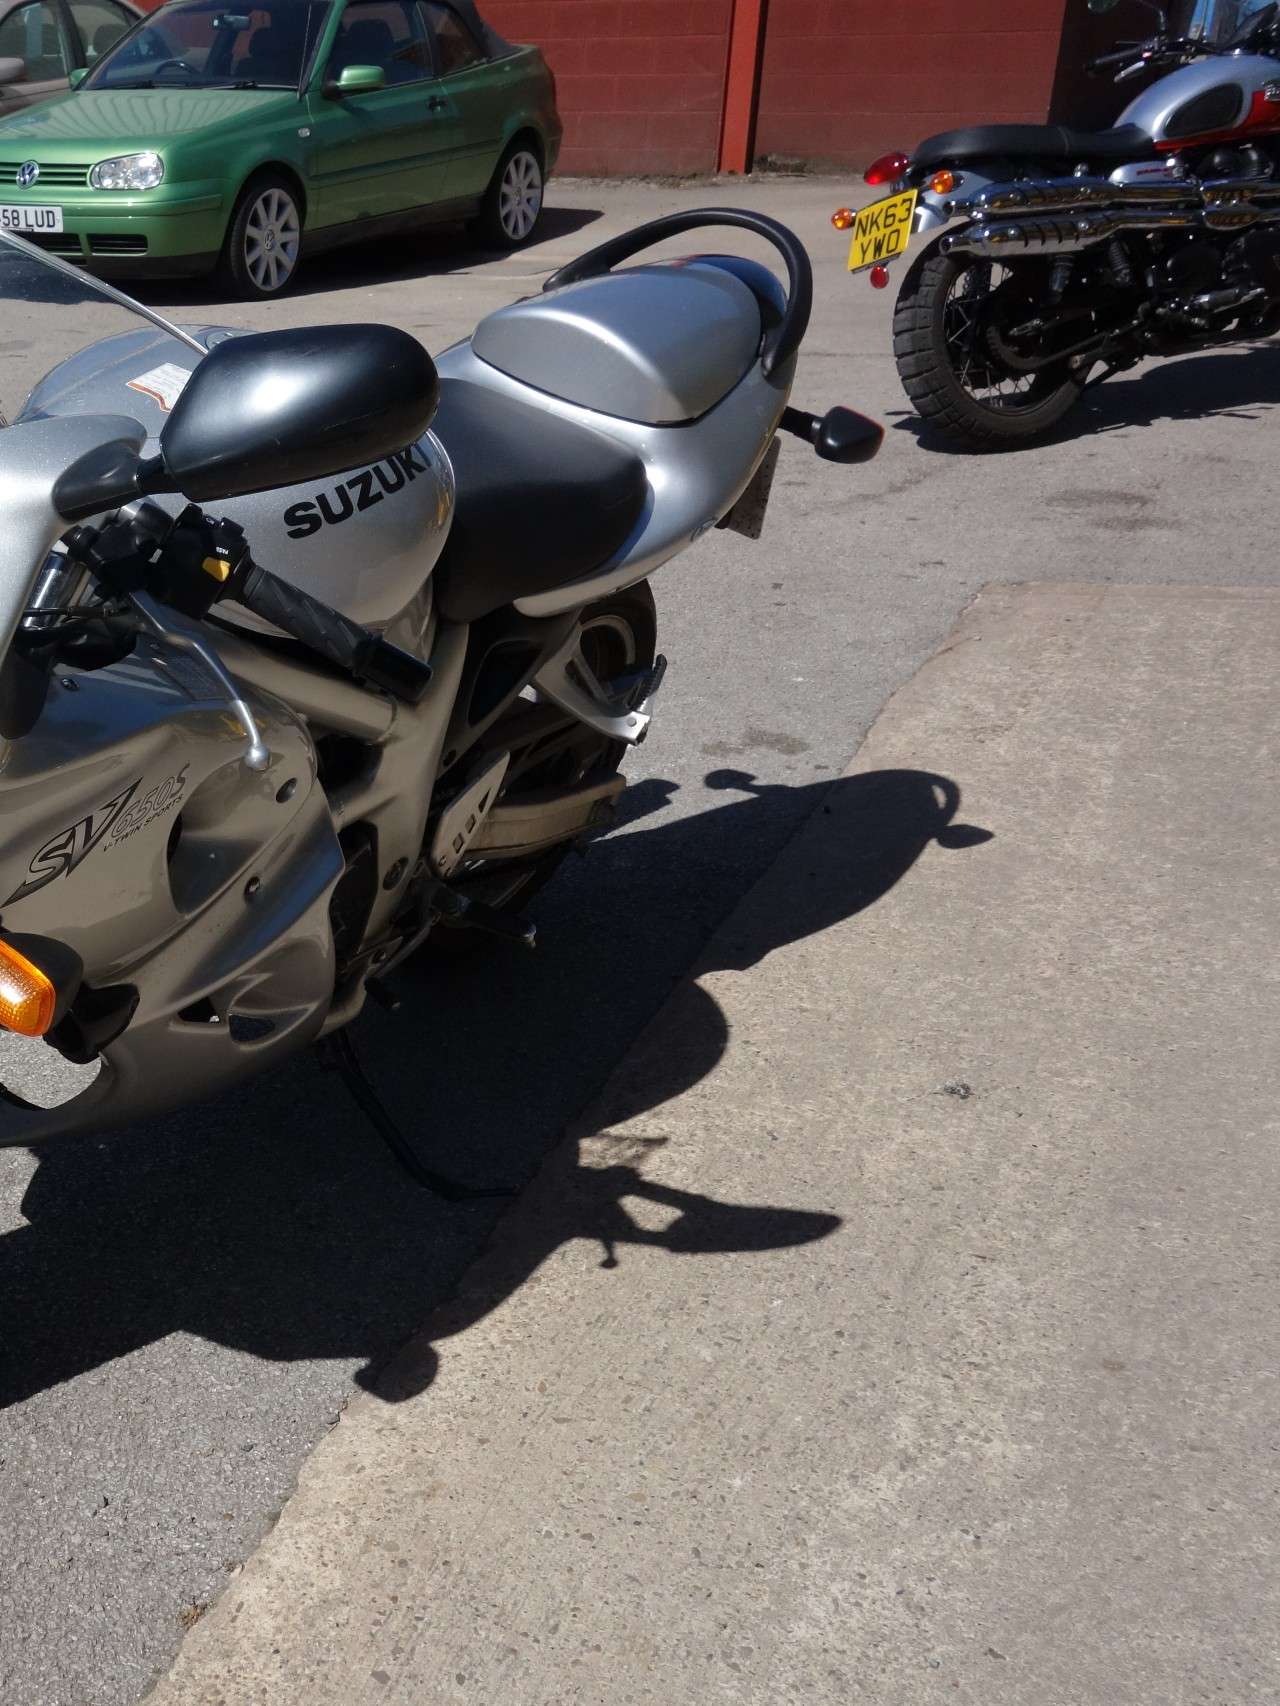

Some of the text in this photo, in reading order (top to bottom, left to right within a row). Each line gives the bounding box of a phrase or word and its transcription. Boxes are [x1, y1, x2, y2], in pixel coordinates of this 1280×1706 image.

[23, 209, 56, 229] LUD
[854, 197, 913, 241] NK63
[283, 443, 432, 540] SUZUKI
